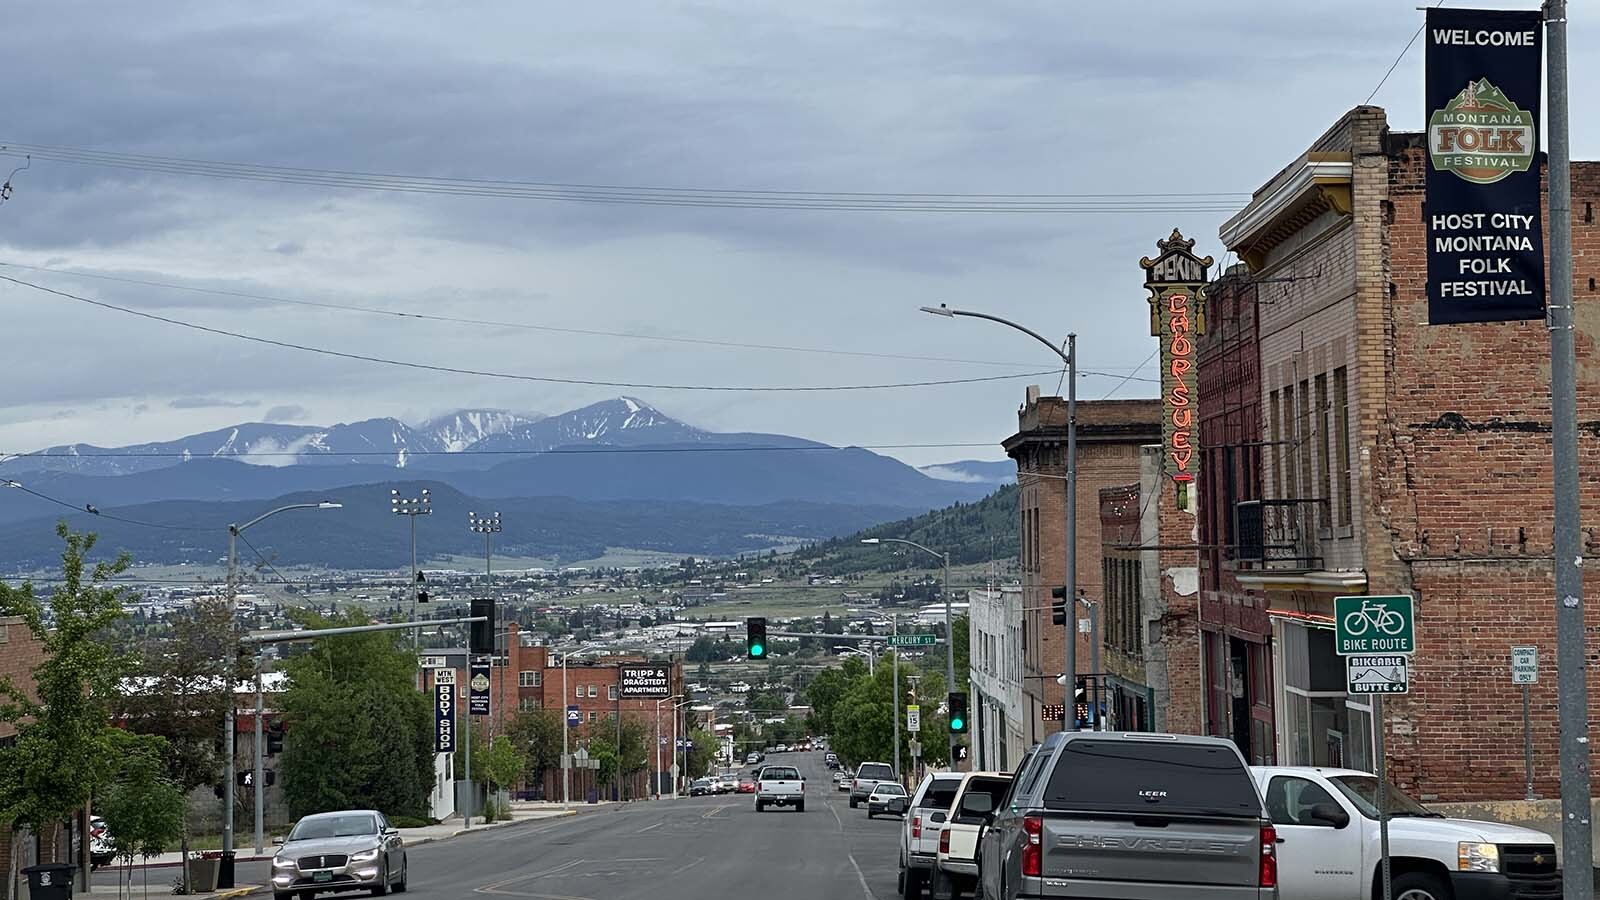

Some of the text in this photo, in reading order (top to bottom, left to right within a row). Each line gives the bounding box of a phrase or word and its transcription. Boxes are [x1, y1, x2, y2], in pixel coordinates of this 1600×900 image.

[1433, 29, 1535, 46] WELCOME
[1443, 113, 1523, 125] MONTANA
[1437, 127, 1525, 153] FOLK
[1444, 156, 1520, 168] FESTIVAL
[1432, 213, 1535, 231] HOST CITY
[1435, 236, 1534, 253] MONTANA
[1153, 253, 1202, 281] PEKIN
[1459, 257, 1512, 275] FOLK
[1441, 279, 1533, 298] FESTIVAL
[1168, 386, 1192, 471] SUEY
[891, 635, 921, 645] MERCURY
[1343, 637, 1408, 651] BIKE ROUTE
[1352, 657, 1402, 666] BIKEABLE
[624, 669, 665, 677] TRIPP &
[623, 678, 667, 686] DRAGSTEDT
[1355, 683, 1390, 692] BUTTE
[439, 685, 451, 750] BODY SHOP
[1043, 704, 1088, 720] OPN
[909, 717, 918, 725] 15
[1056, 833, 1247, 855] CHEVROLET
